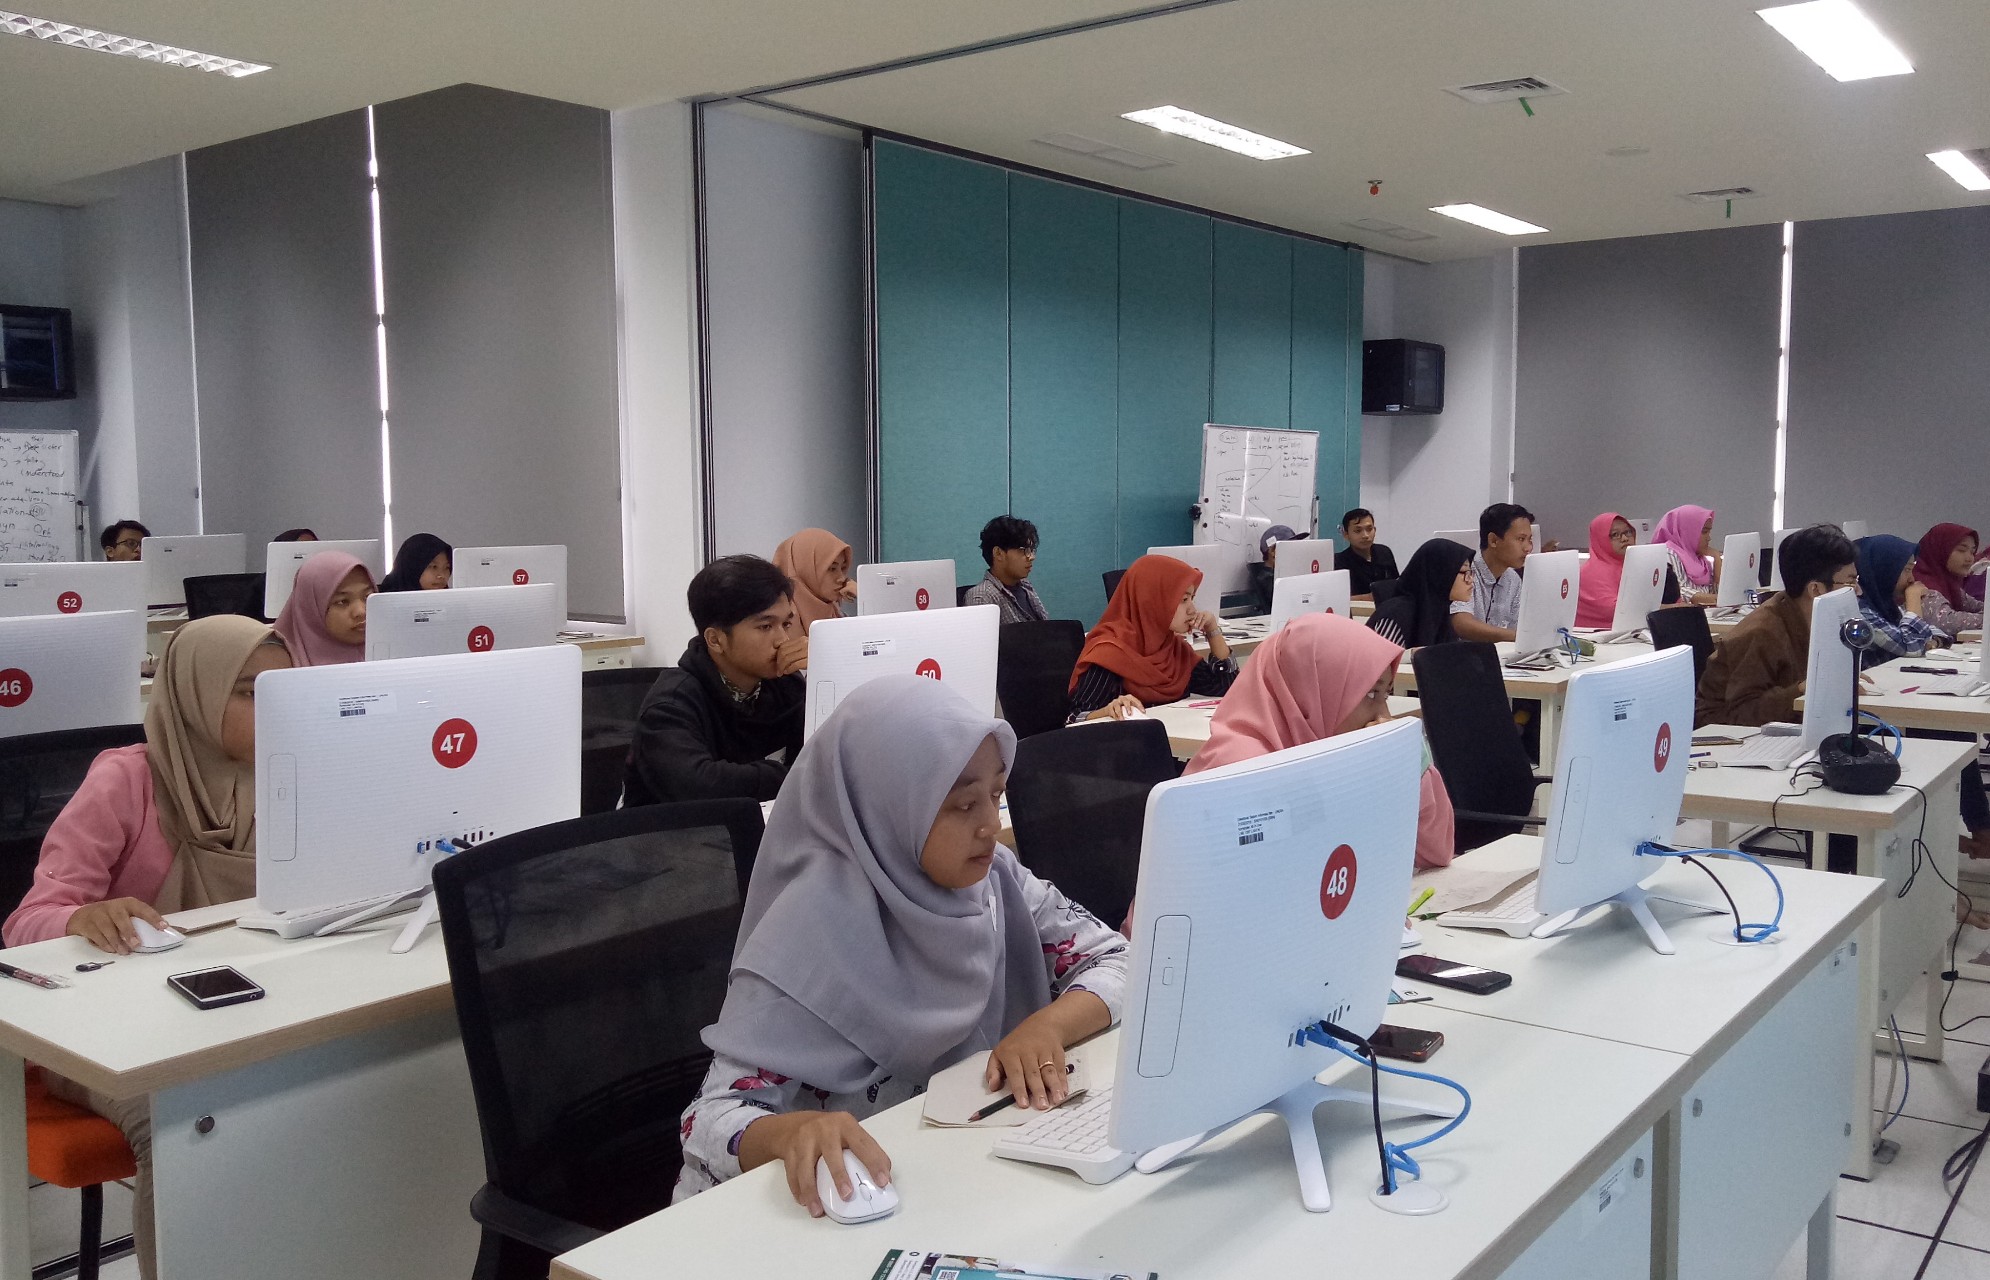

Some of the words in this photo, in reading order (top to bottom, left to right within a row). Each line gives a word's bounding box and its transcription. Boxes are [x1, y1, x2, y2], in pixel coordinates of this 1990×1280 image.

[516, 574, 526, 583] 57
[63, 598, 77, 608] 52
[918, 594, 927, 605] 58
[474, 634, 489, 648] 51
[0, 679, 22, 696] 46
[440, 732, 466, 754] 47
[1657, 737, 1669, 758] 49
[1326, 866, 1348, 899] 48
